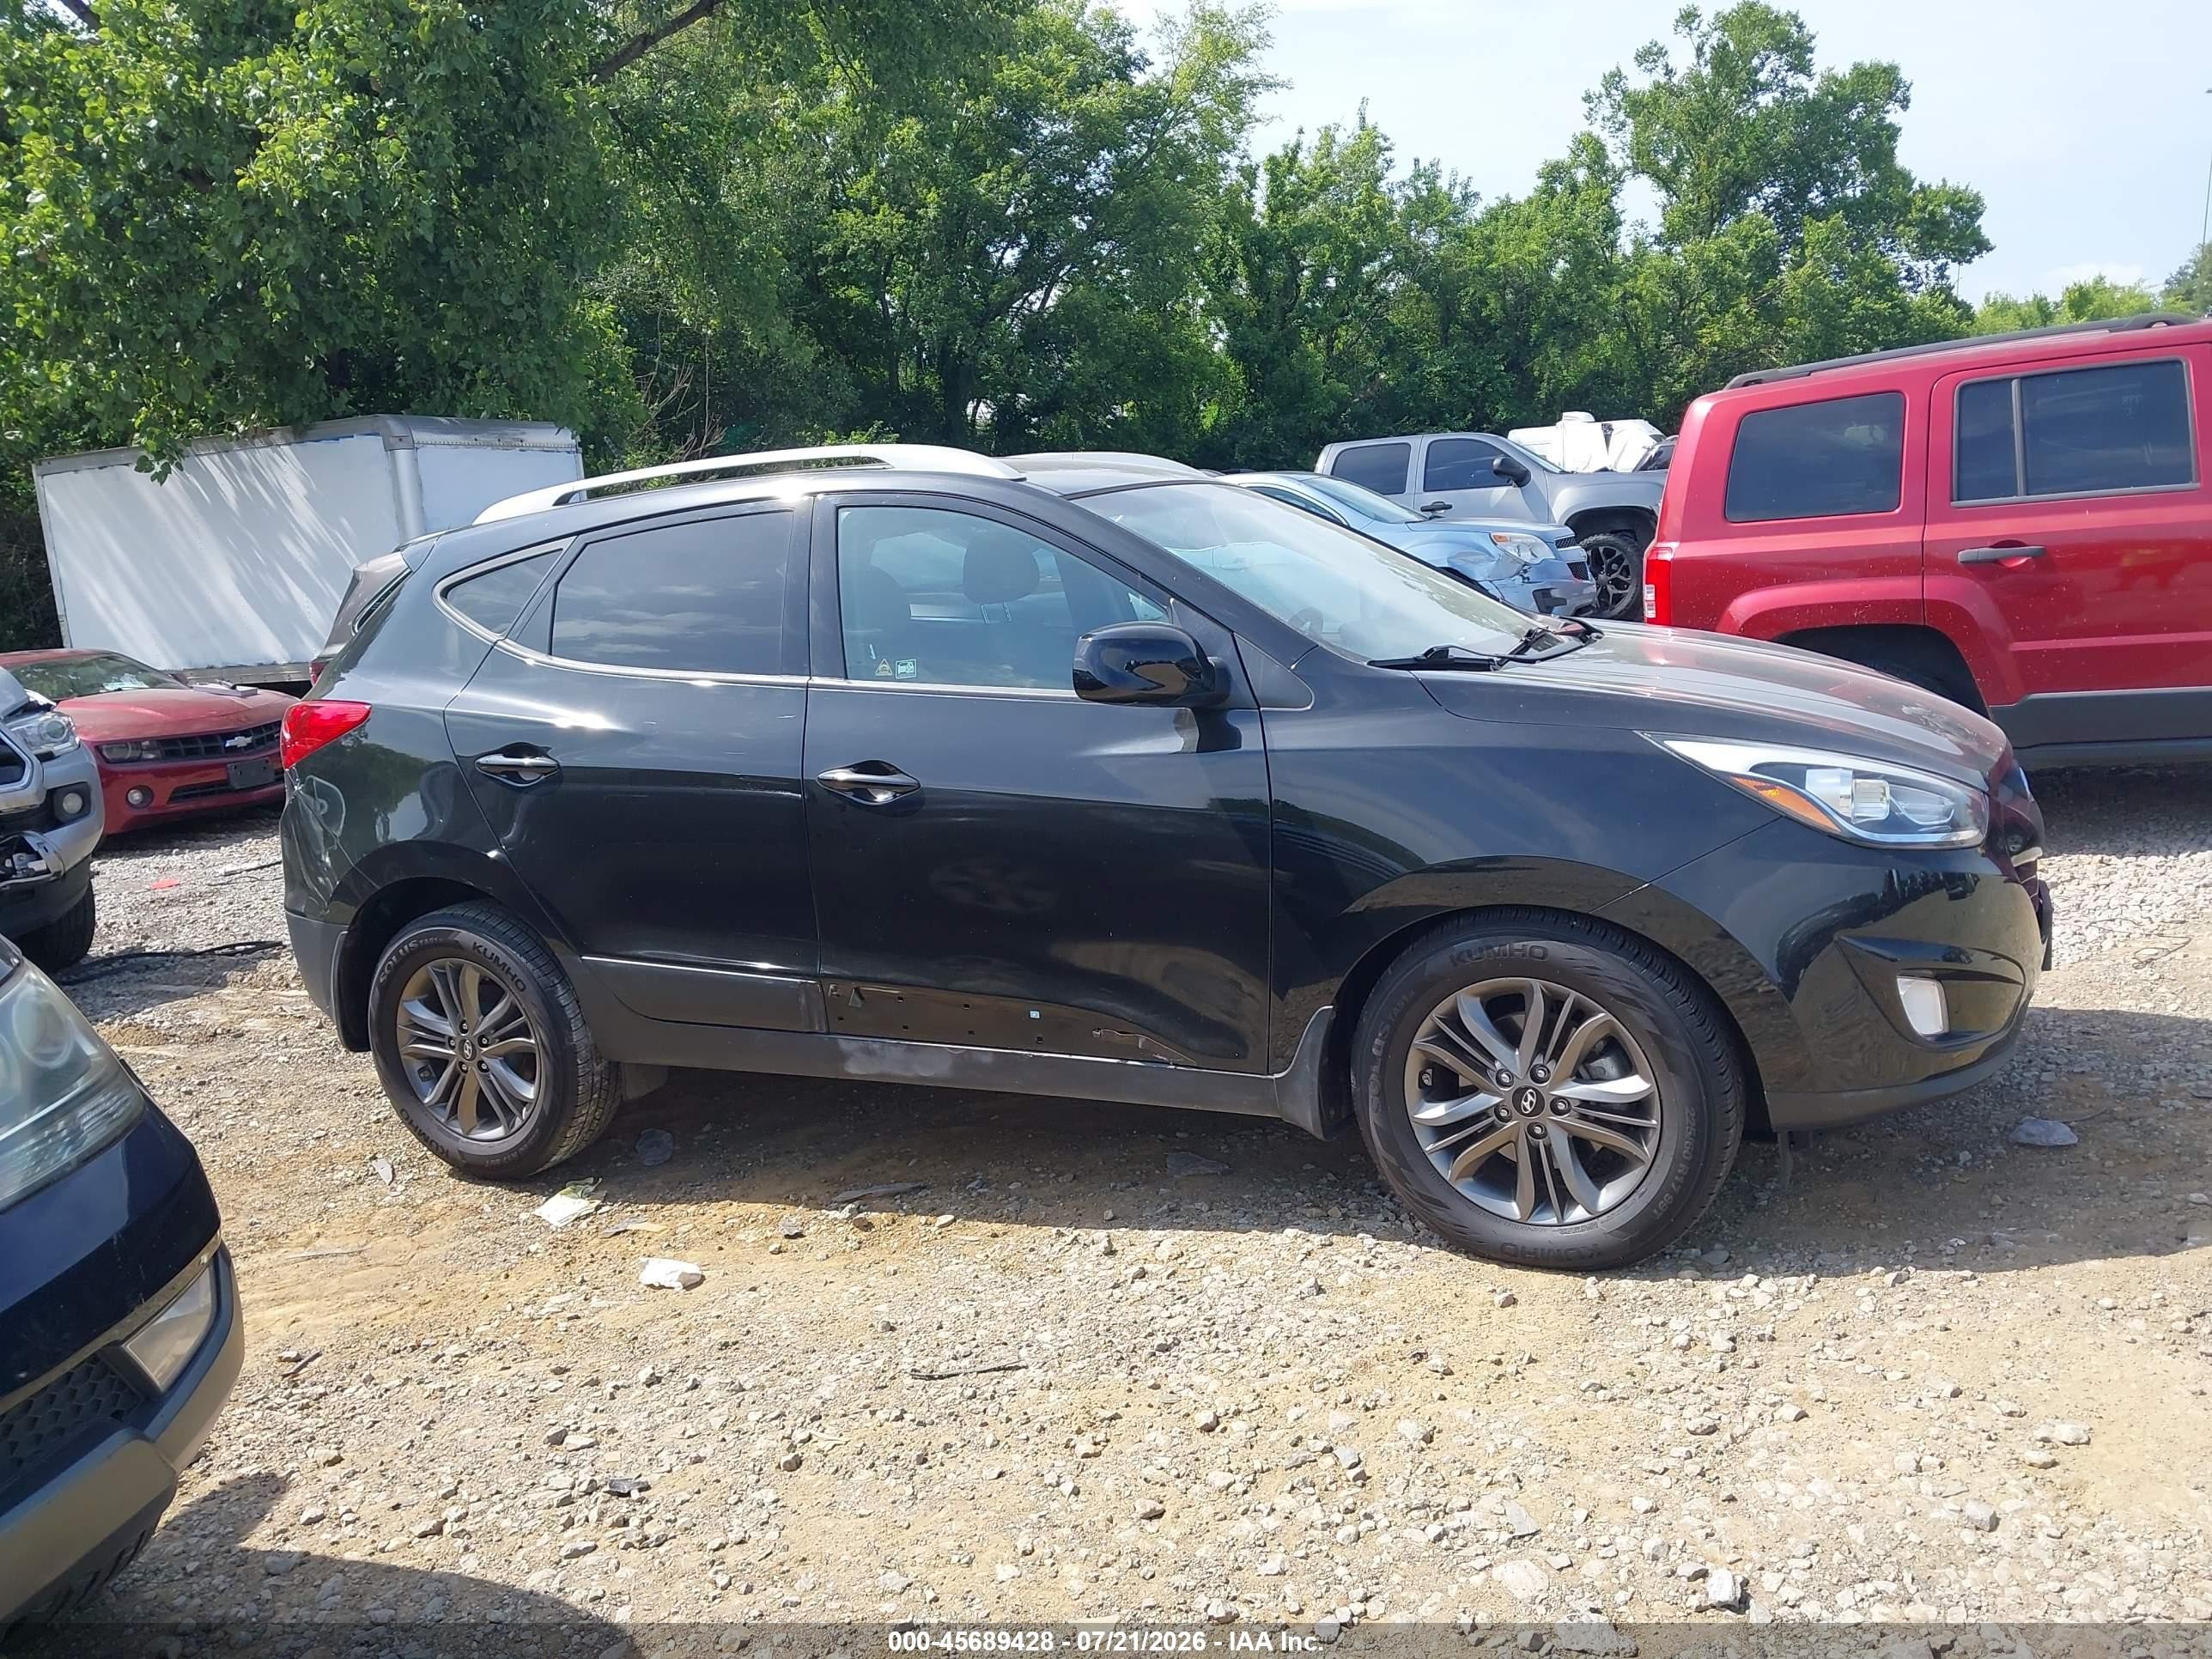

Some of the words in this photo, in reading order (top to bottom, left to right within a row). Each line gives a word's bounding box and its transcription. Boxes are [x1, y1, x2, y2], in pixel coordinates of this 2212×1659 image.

[379, 939, 420, 984] SOLUS
[473, 942, 526, 993] KUMHO
[1449, 944, 1548, 967] KUMHO
[1369, 1022, 1390, 1115] SOLUS
[1671, 1163, 1690, 1193] R17
